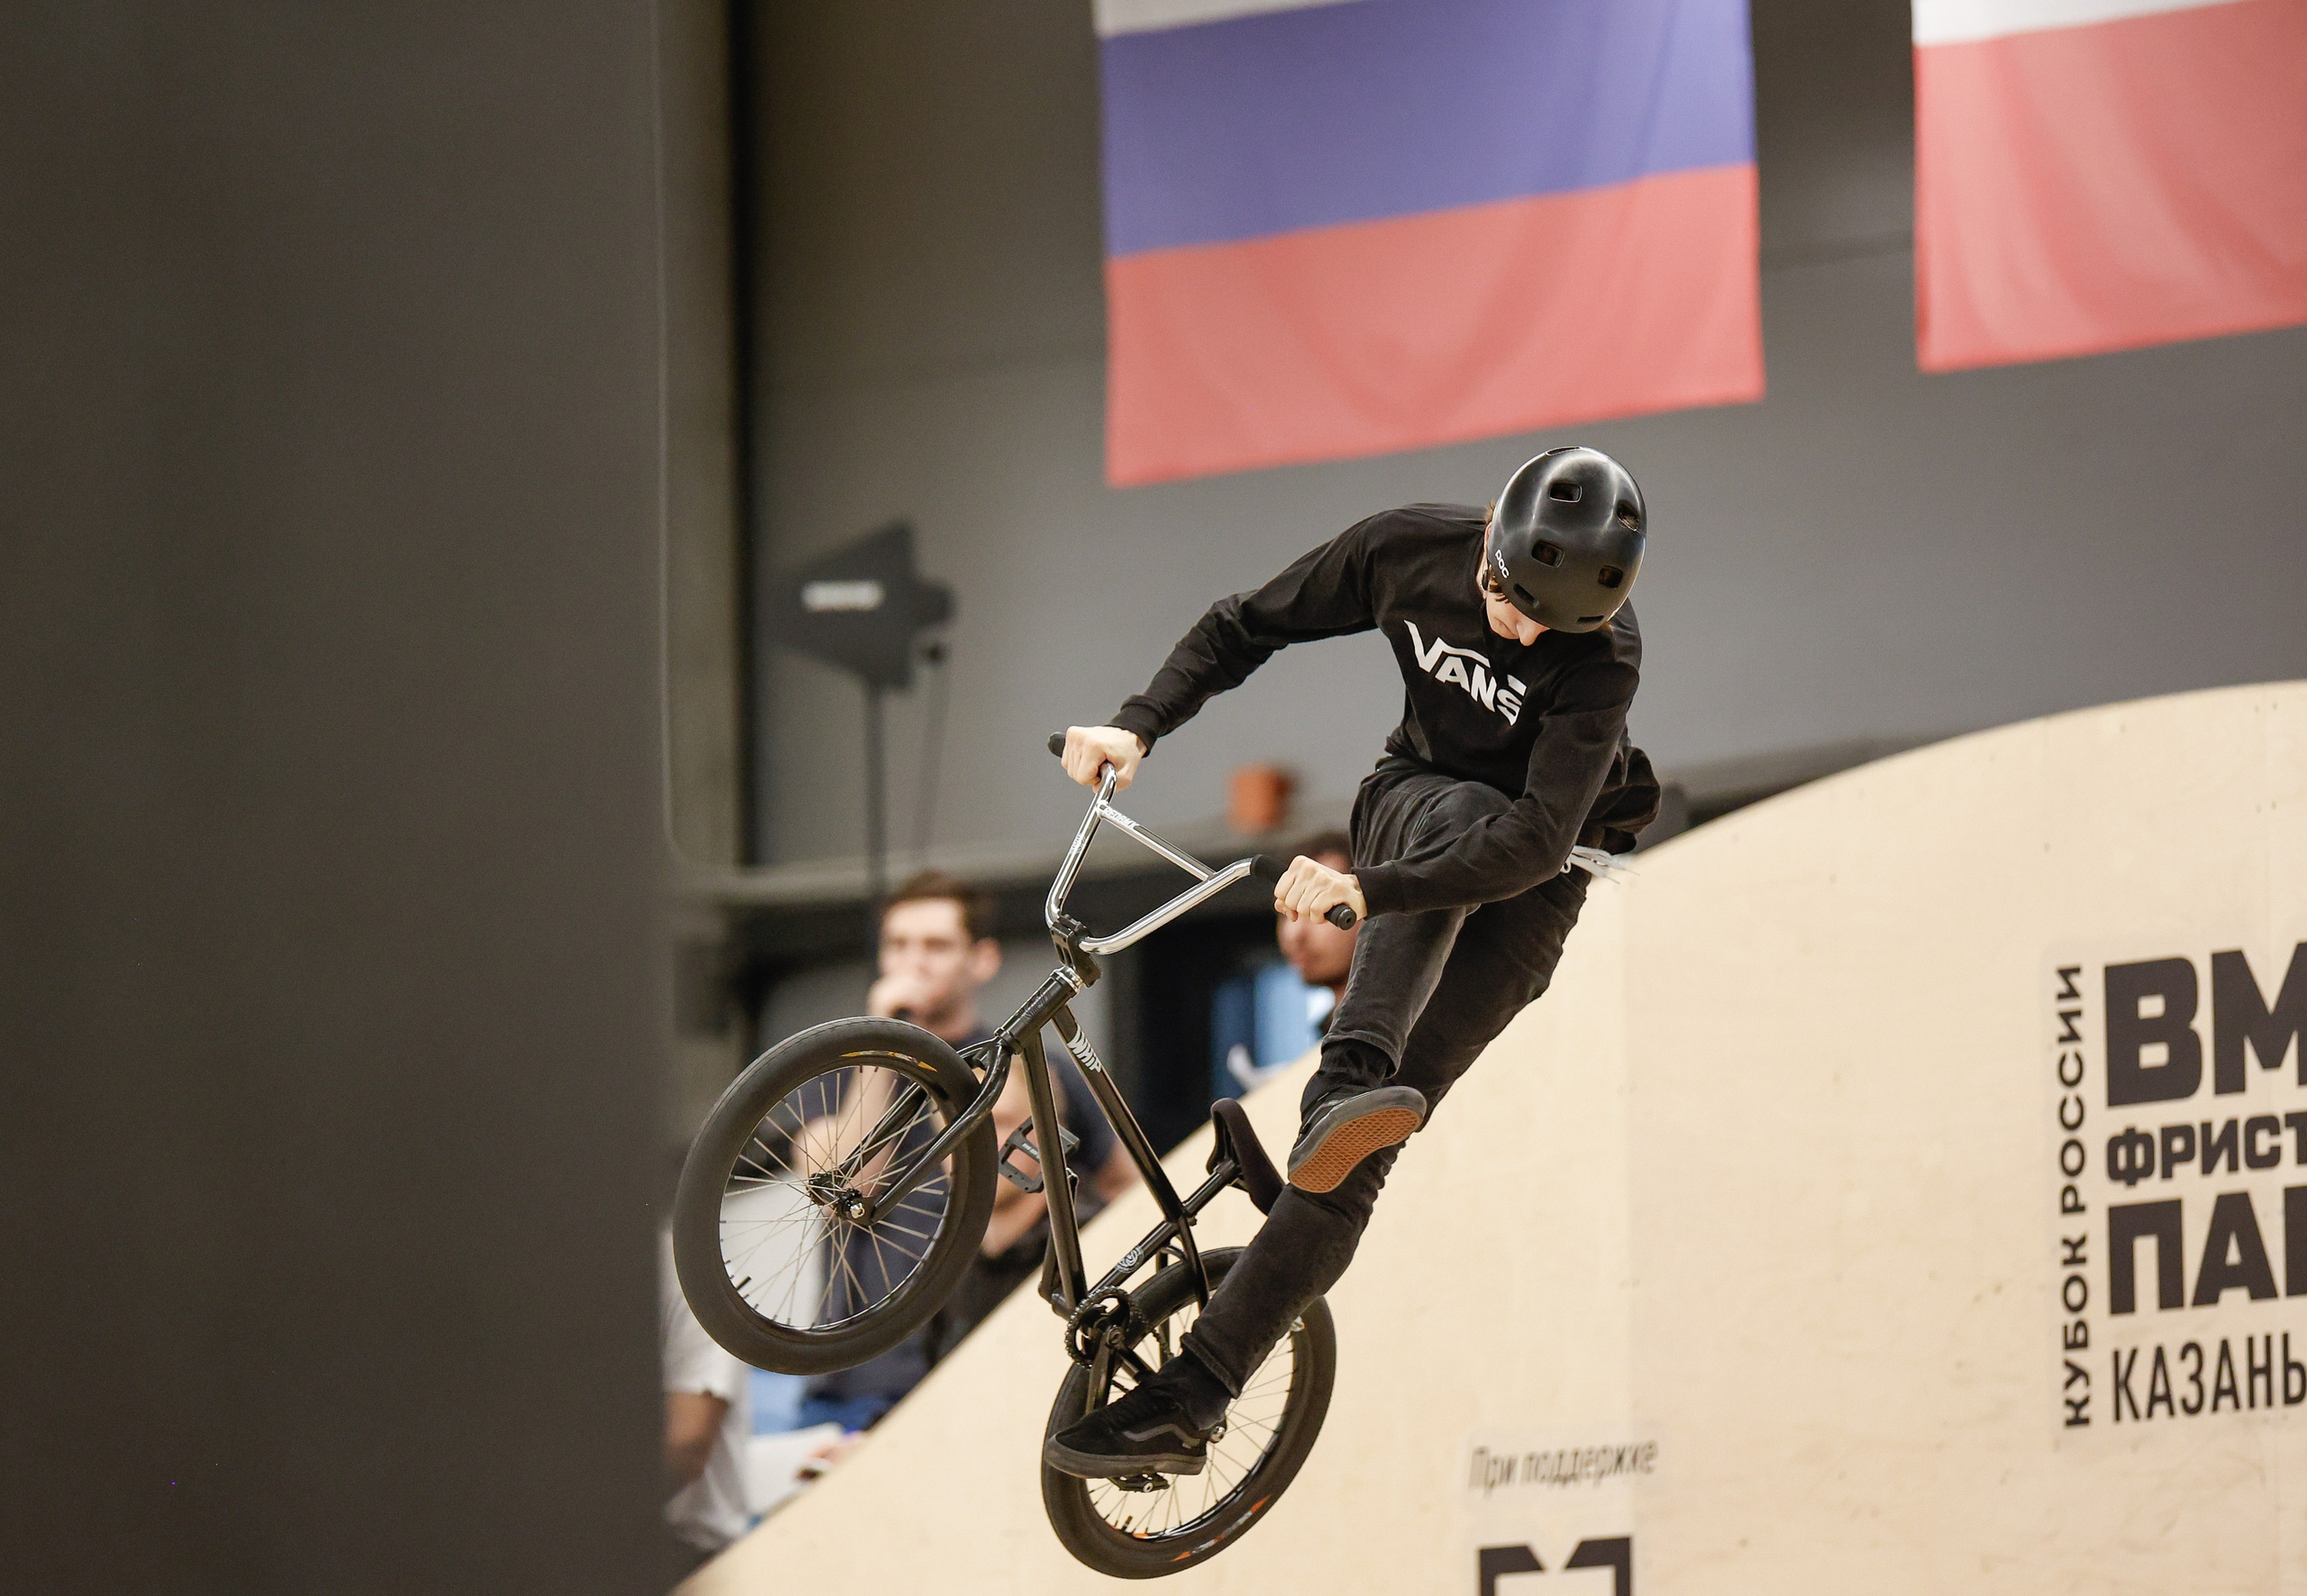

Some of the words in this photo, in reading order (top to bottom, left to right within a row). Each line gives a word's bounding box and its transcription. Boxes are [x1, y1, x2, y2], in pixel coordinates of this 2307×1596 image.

[1403, 619, 1527, 726] VANS
[2056, 965, 2087, 1217] РОССИИ
[2061, 1234, 2092, 1429] КУБОК
[2112, 1331, 2307, 1424] КАЗАНЬ
